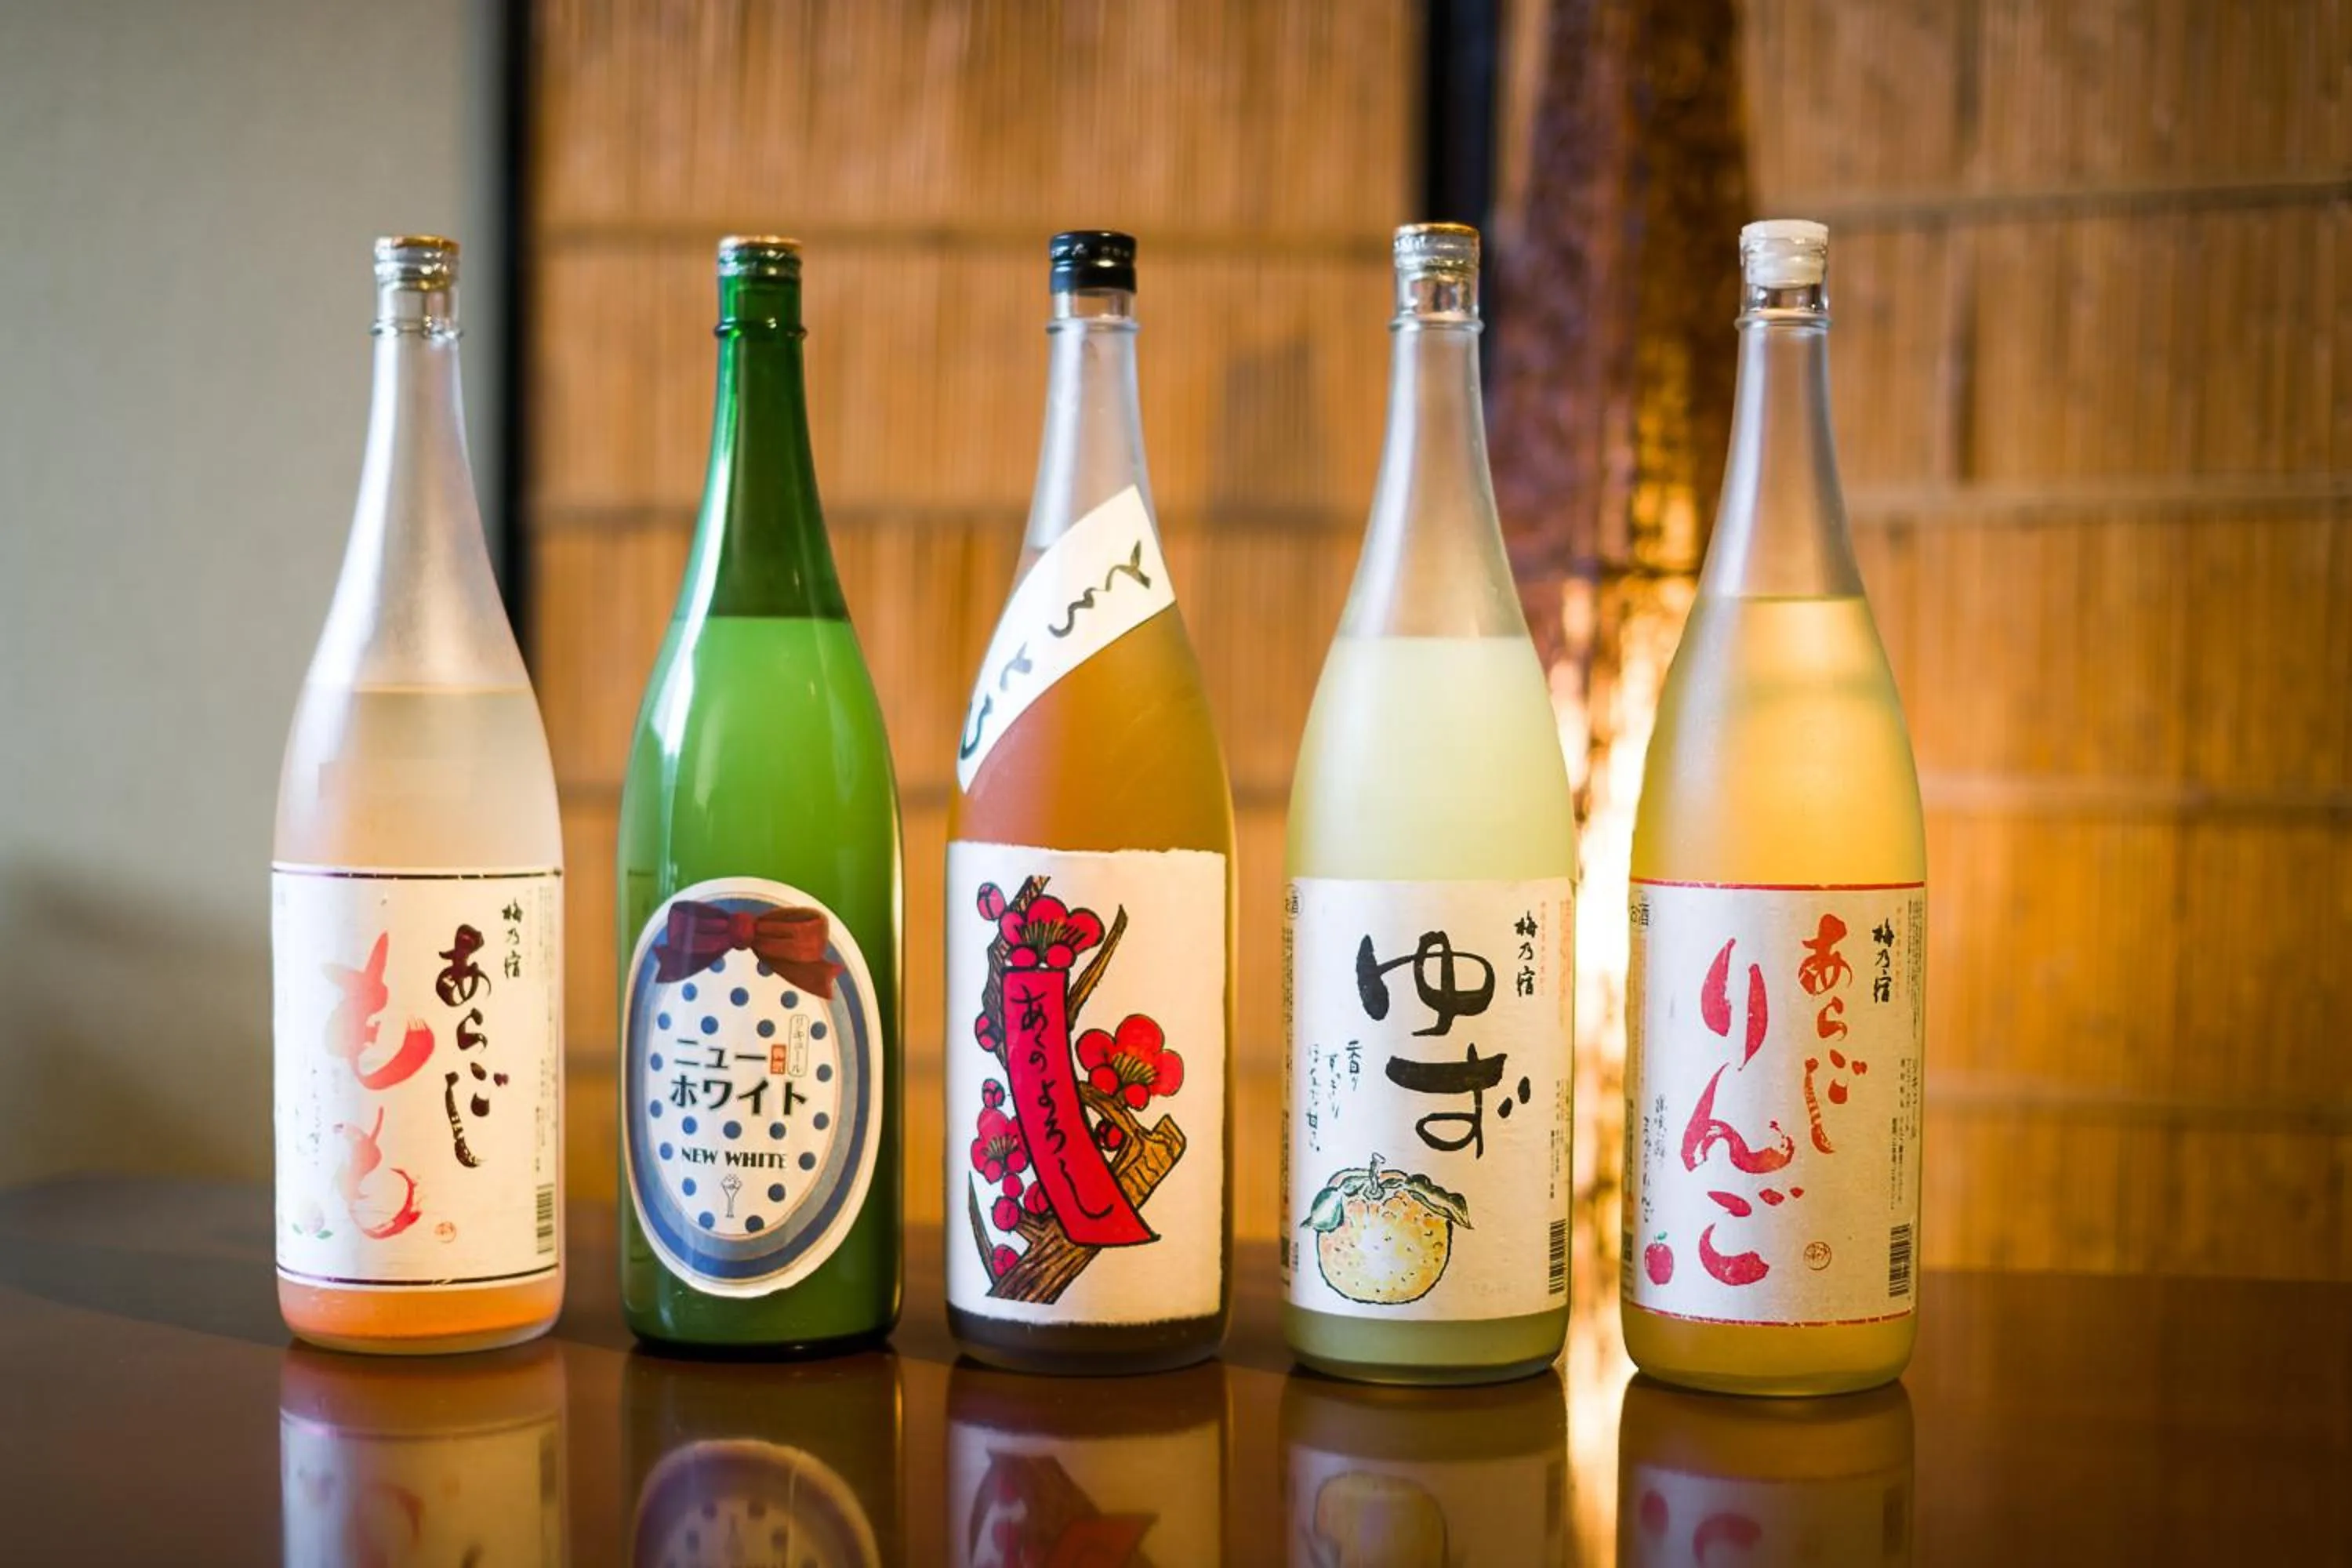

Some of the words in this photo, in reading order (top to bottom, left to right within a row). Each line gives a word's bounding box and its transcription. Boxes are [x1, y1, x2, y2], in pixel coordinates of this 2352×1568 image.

[502, 897, 524, 978] 梅乃宿
[1515, 910, 1537, 997] 梅乃宿
[1872, 917, 1894, 1003] 梅乃宿
[436, 924, 510, 1167] あらごし
[674, 1039, 767, 1069] ニュー
[1356, 931, 1531, 1158] ゆず
[1798, 913, 1867, 1154] あらごし
[321, 928, 435, 1240] もも
[670, 1075, 807, 1116] ホワイト
[1681, 938, 1804, 1287] りんご
[681, 1147, 718, 1165] NEW
[724, 1151, 787, 1168] WHITE
